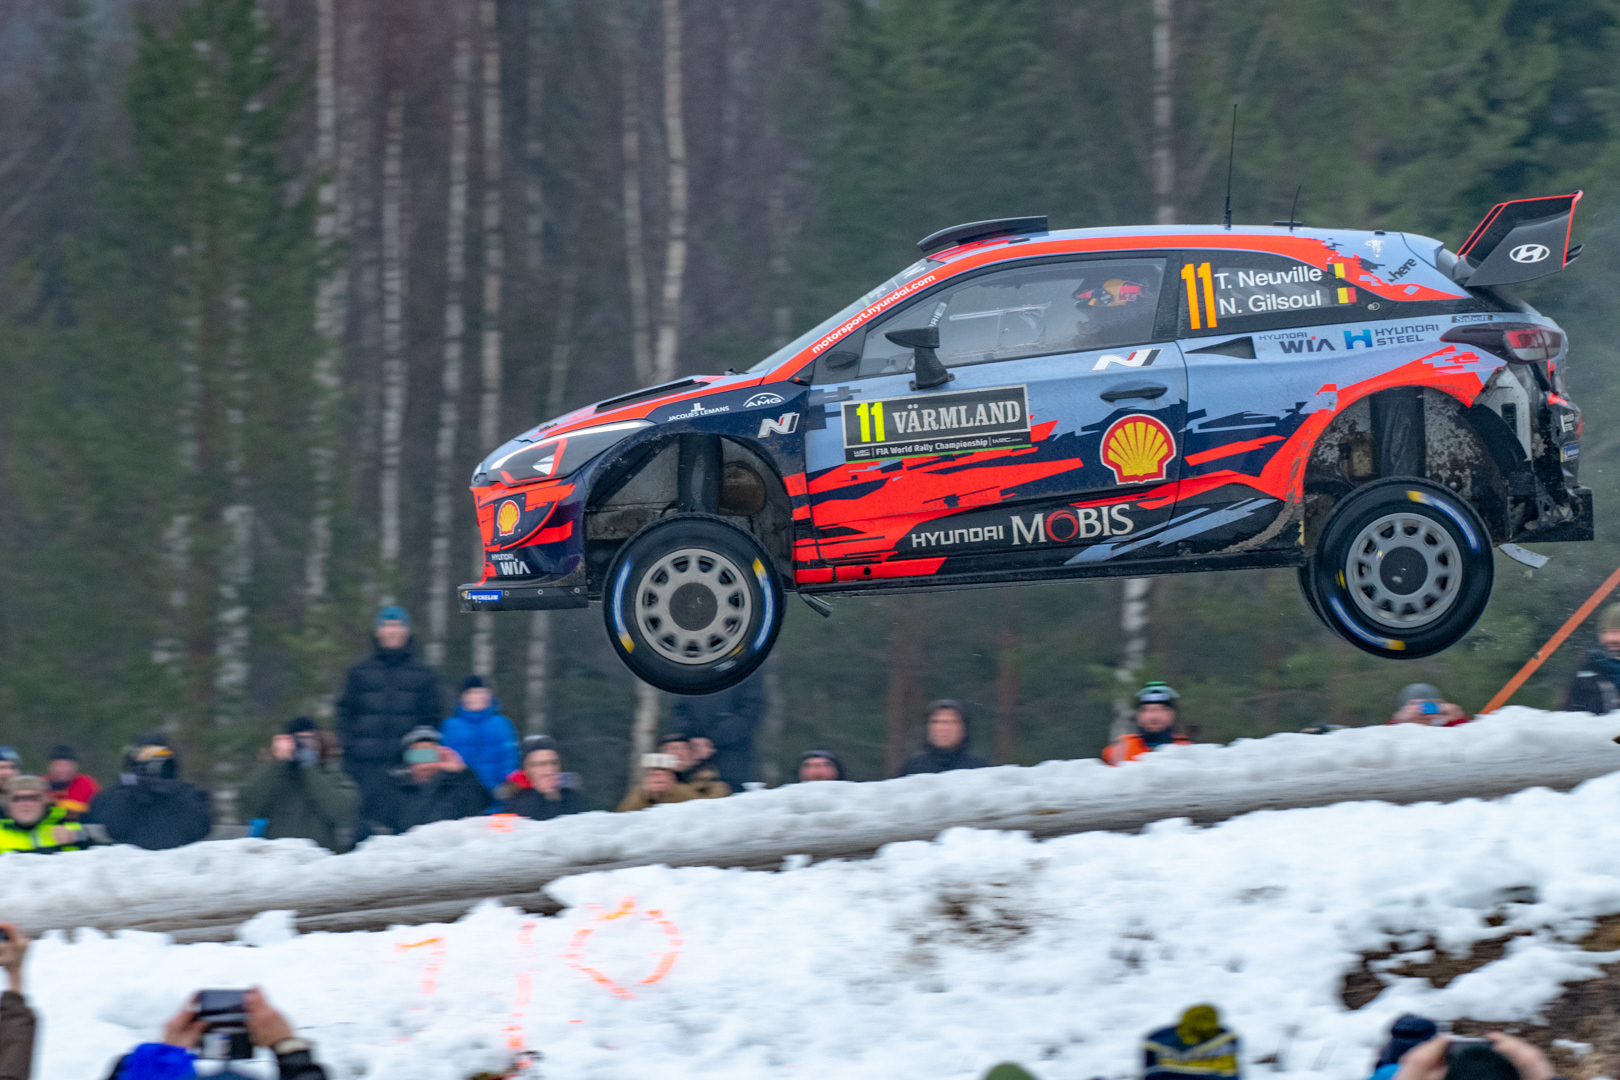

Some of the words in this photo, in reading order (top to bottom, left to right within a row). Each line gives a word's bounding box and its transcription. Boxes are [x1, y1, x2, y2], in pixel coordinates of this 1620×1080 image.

[1214, 272, 1232, 289] T.
[1238, 266, 1322, 288] Neuville
[1388, 258, 1417, 280] here
[1181, 262, 1217, 329] 11
[1219, 297, 1242, 315] N.
[1249, 290, 1322, 312] Gilsoul
[811, 274, 936, 354] motorsport.hyundai.com
[1259, 332, 1307, 340] HYUNDAI
[1375, 324, 1439, 336] HYUNDAI
[1377, 335, 1424, 346] STEEL
[667, 411, 699, 421] JACQUES
[700, 405, 730, 416] LEMANS
[856, 402, 885, 443] 11
[892, 400, 1021, 434] VÄRMLAND
[876, 447, 889, 455] FIA
[890, 445, 913, 454] World
[914, 443, 933, 452] Rally
[935, 438, 988, 449] Championship
[911, 525, 1004, 547] HYUNDAI
[1010, 504, 1134, 545] MOBIS
